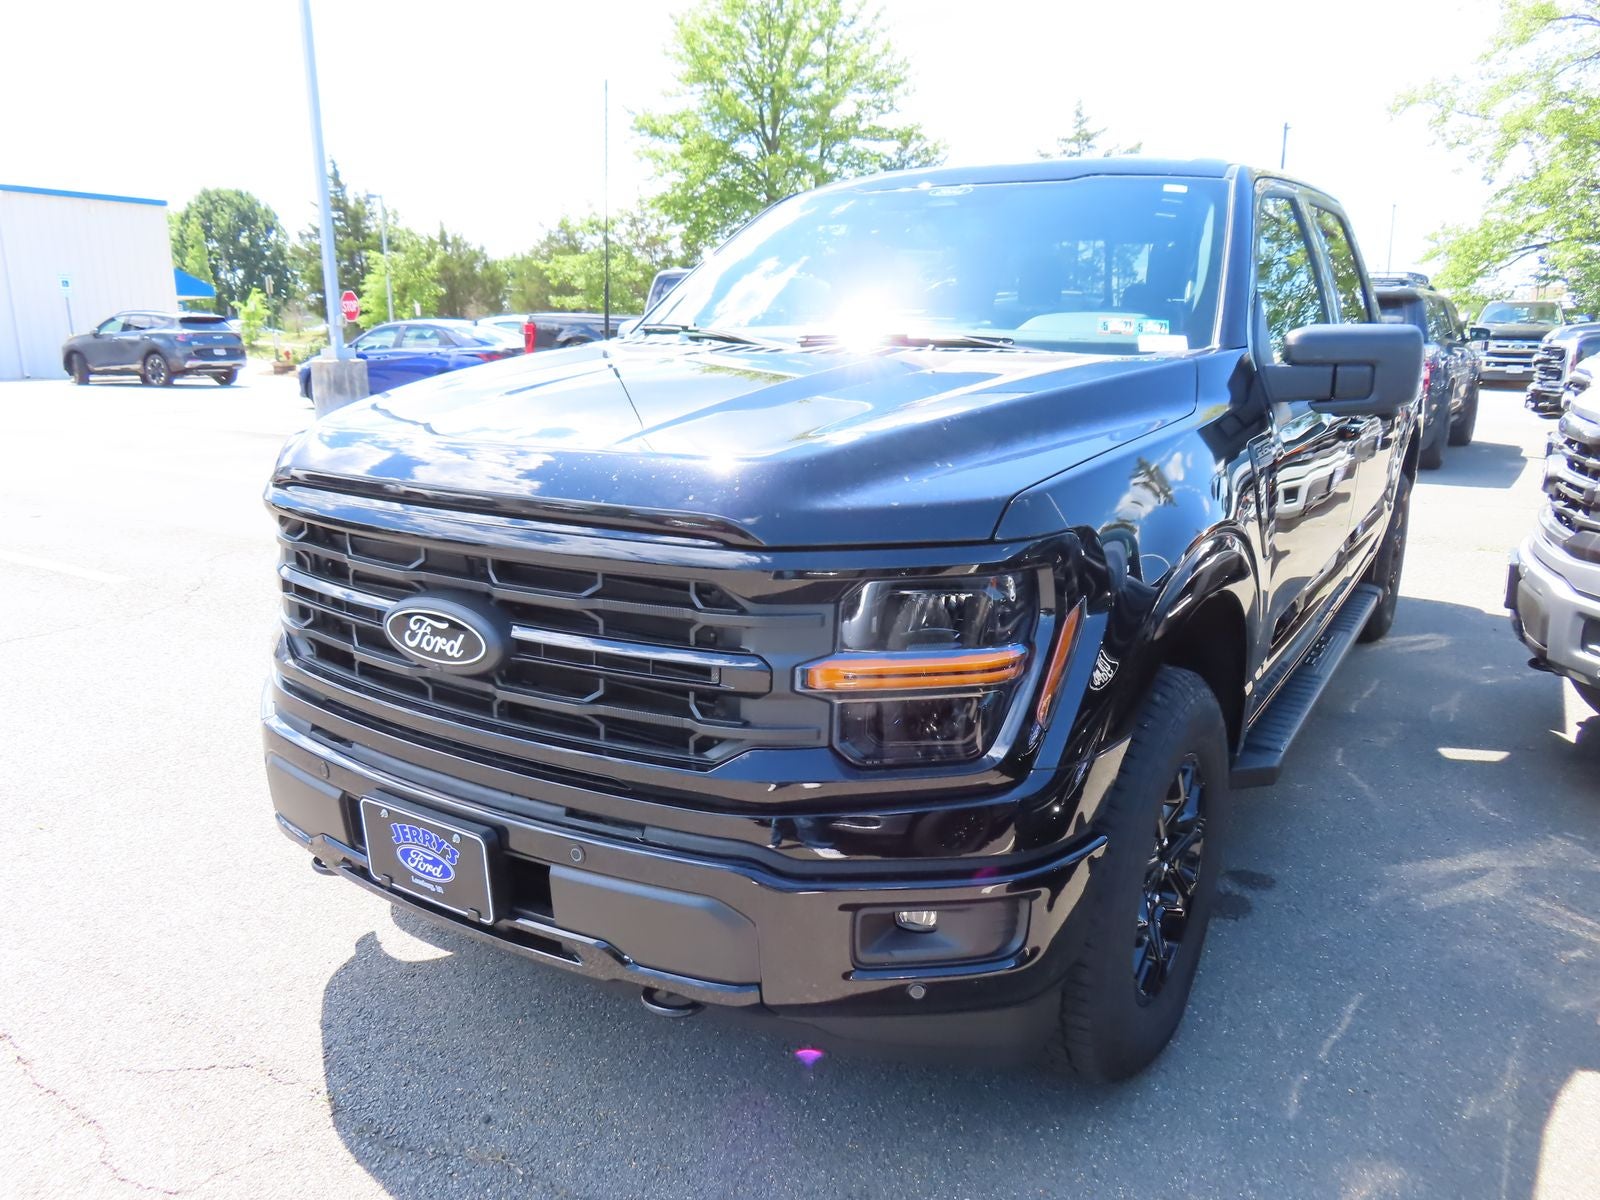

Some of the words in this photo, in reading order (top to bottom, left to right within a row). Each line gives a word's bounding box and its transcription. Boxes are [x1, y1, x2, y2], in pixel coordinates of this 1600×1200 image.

[342, 300, 358, 313] STOP
[404, 615, 465, 658] Ford
[391, 822, 460, 866] JERRY'S
[407, 849, 444, 878] Ford
